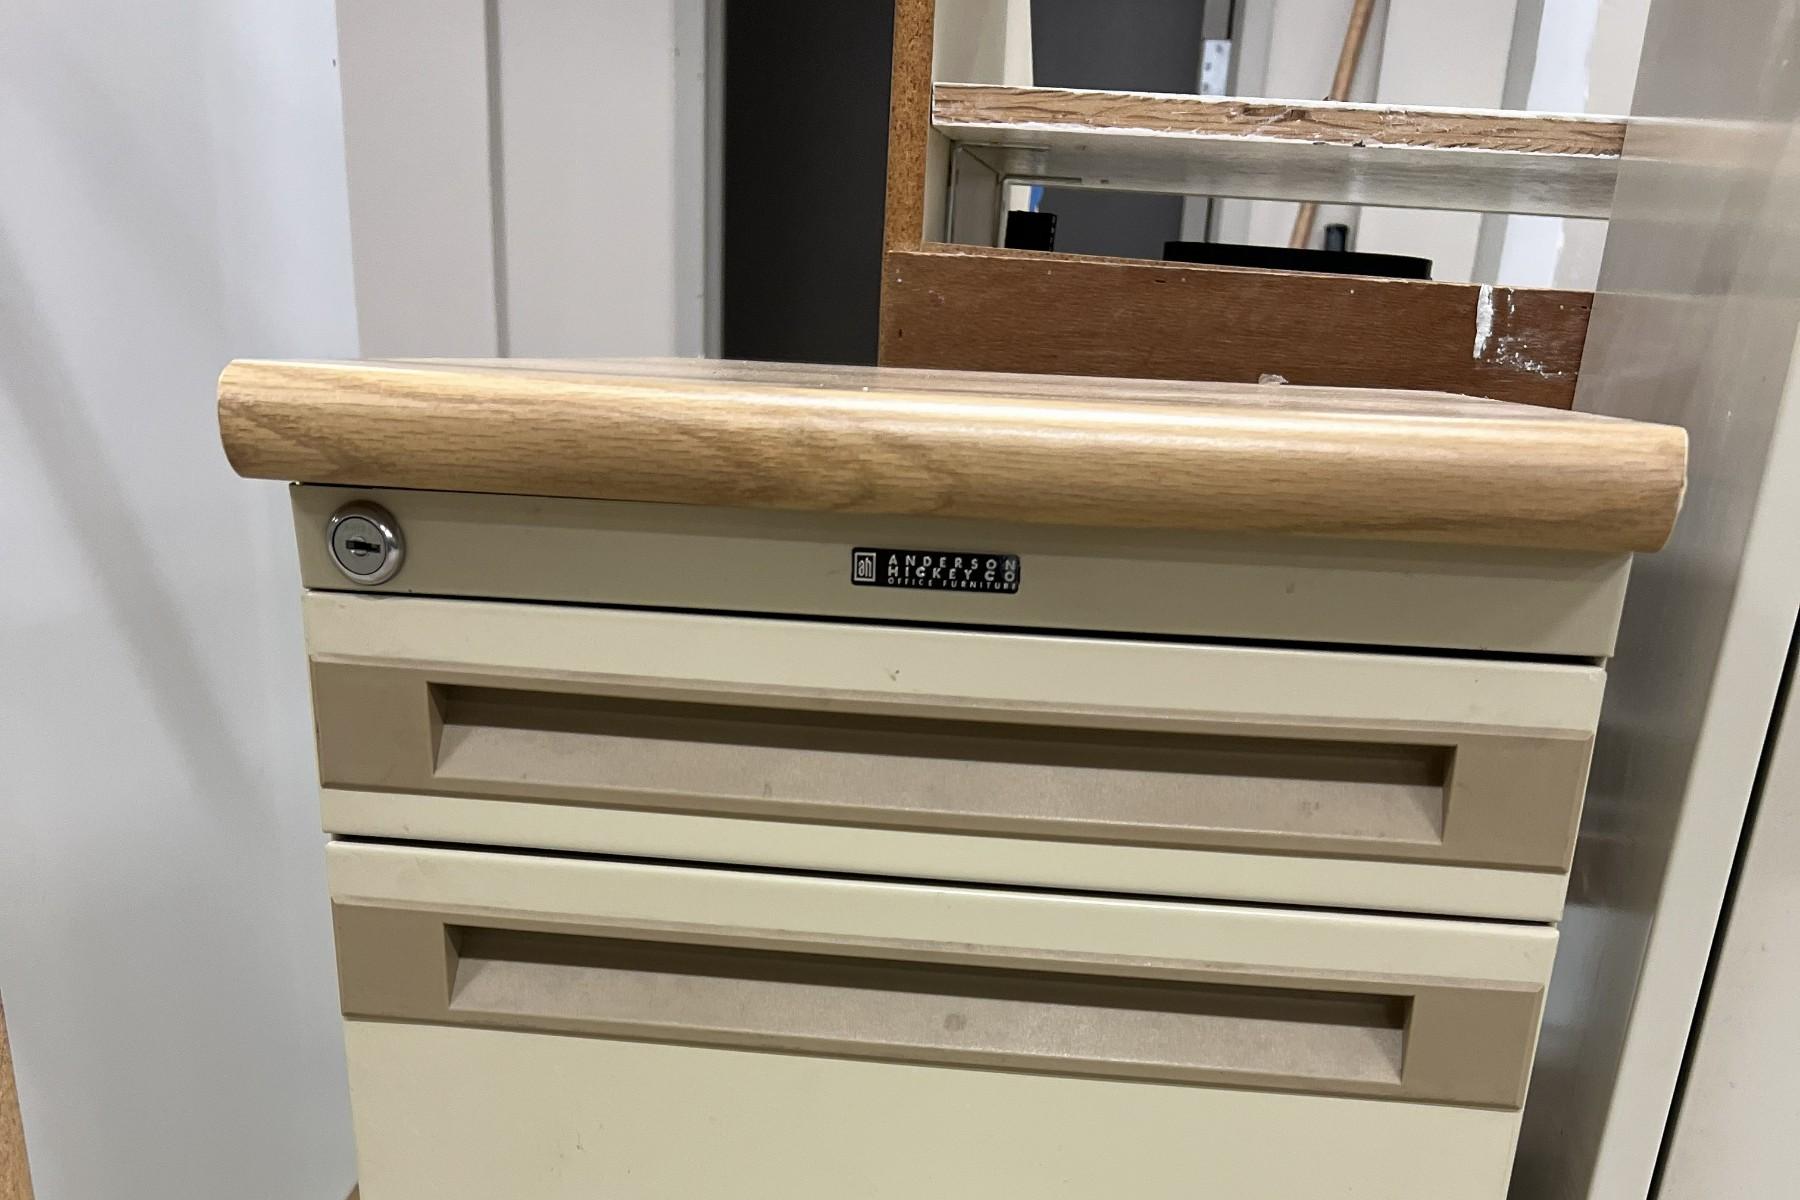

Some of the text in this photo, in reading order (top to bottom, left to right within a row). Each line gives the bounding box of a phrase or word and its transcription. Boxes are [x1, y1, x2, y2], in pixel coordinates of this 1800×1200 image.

[888, 553, 1016, 571] ANDERSON
[887, 566, 1016, 582] HICKEY CO
[887, 576, 1017, 591] OFFICE FURNITURE
